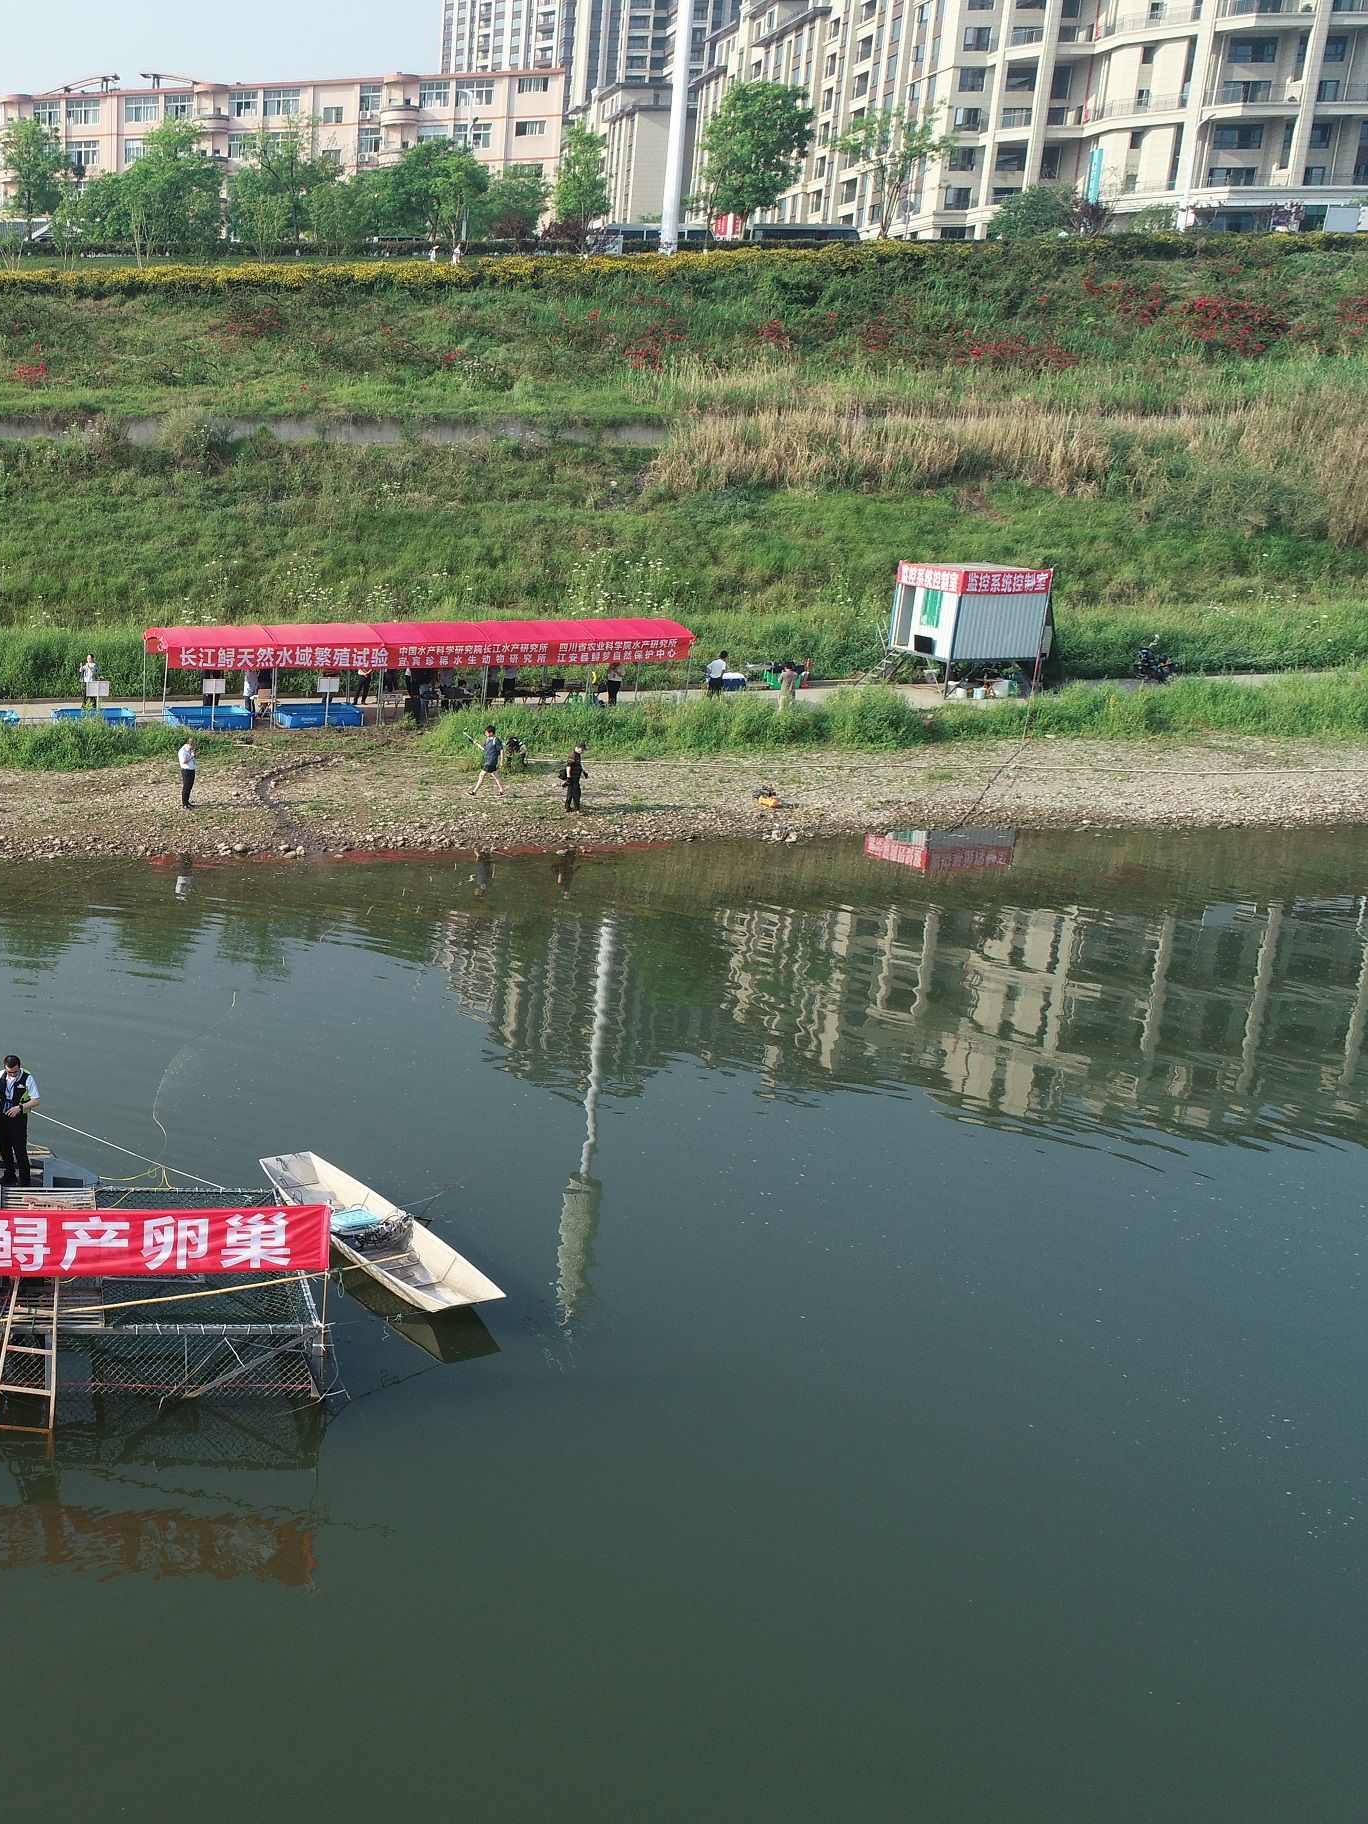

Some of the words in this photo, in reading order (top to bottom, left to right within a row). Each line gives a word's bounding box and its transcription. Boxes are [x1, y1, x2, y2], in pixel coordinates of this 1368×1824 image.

[901, 564, 959, 592] 监控系统控制室
[966, 573, 1048, 593] 监控系统控制室
[399, 643, 548, 656] 中国水产科学研究院长江水产研究所
[559, 638, 678, 652] 四川省农业科学院水产研究所
[179, 646, 389, 668] 长江鲟天然水域繁殖试验
